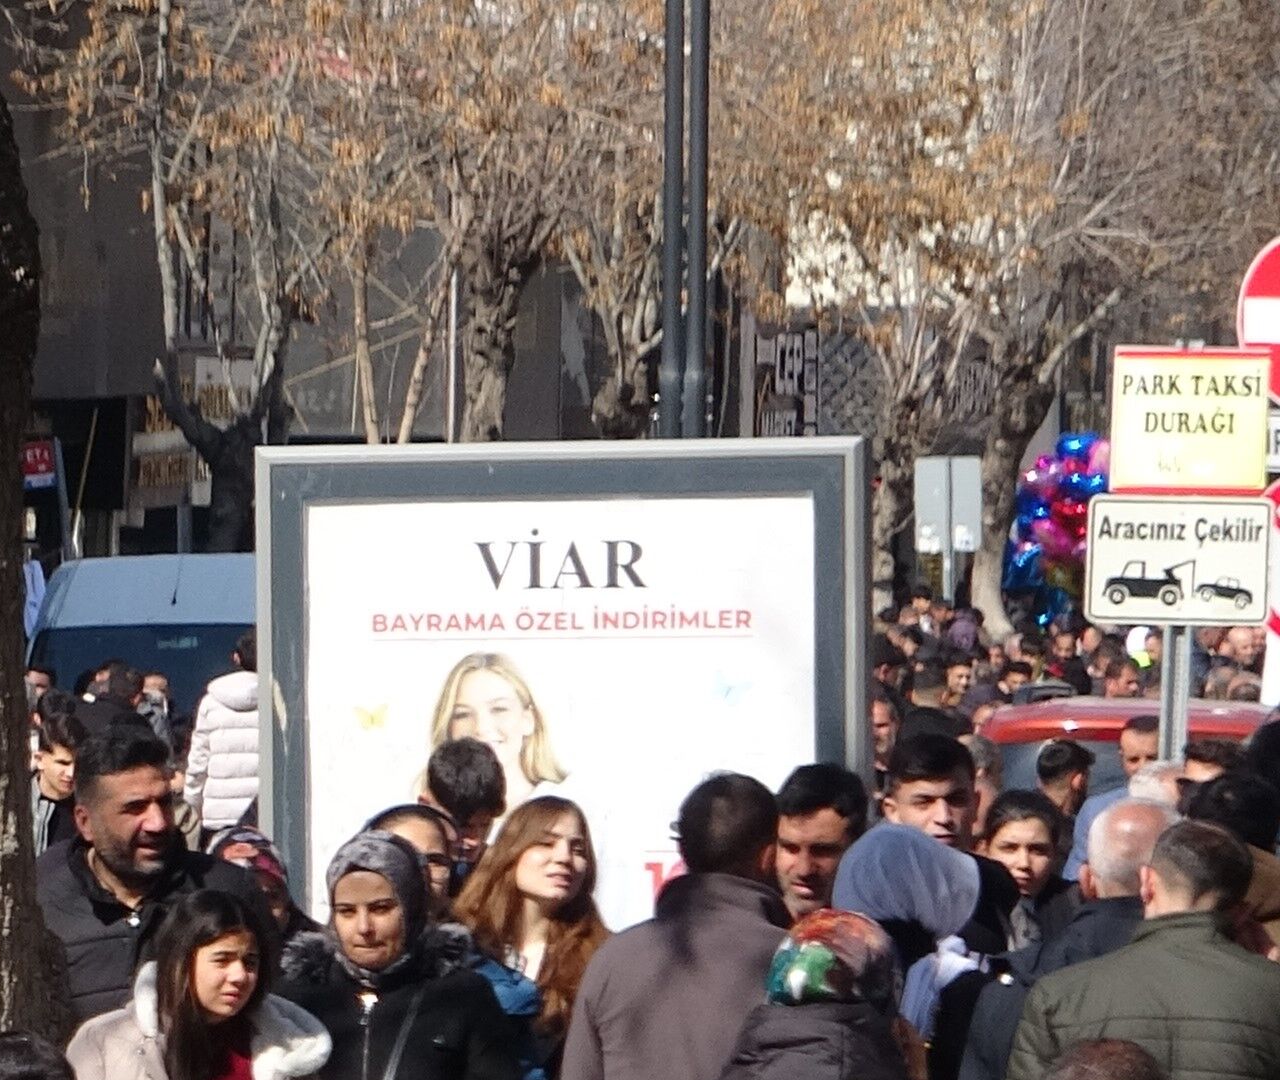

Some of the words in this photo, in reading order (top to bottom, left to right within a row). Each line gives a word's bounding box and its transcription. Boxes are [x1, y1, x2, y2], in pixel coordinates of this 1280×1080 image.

[1121, 374, 1182, 396] PARK
[1190, 369, 1262, 397] TAKSİ
[1144, 406, 1235, 434] DURAĞI
[1098, 515, 1186, 541] Aracınız
[1194, 517, 1264, 548] Çekilir
[474, 528, 648, 591] VİAR
[372, 612, 505, 633] BAYRAMA
[516, 606, 584, 631] ÖZEL
[593, 604, 752, 630] İNDİRİMLER
